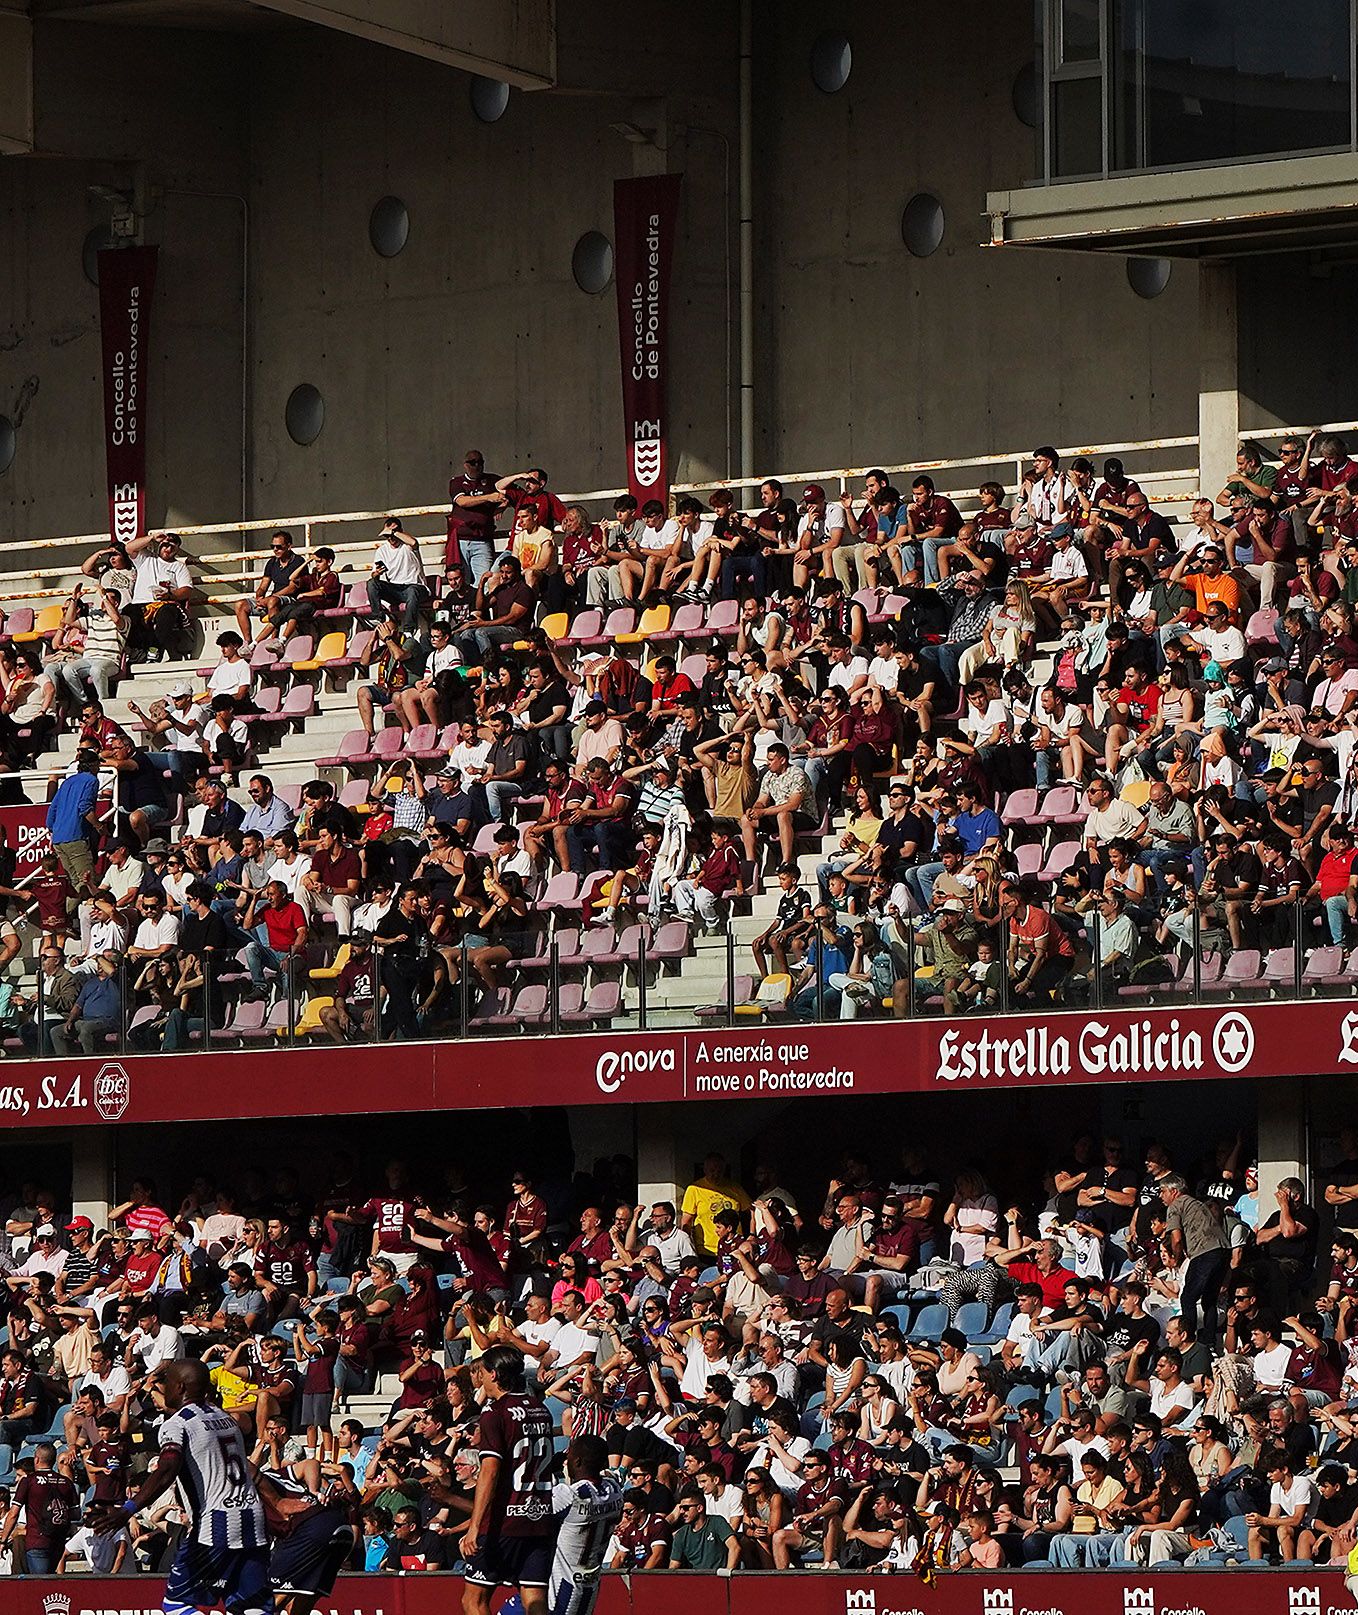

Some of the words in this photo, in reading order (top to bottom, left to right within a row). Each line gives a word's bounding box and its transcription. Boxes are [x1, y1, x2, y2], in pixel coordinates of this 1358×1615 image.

[646, 214, 659, 345] Pontevedra
[632, 282, 643, 381] Concello
[646, 351, 659, 379] de
[113, 351, 124, 446] Concello
[696, 1042, 709, 1063] A
[714, 1039, 773, 1063] enerxía
[777, 1043, 809, 1065] que
[935, 1026, 1072, 1081] Estrella
[1078, 1018, 1205, 1075] Galicia
[37, 1074, 88, 1110] S.A.
[696, 1074, 740, 1092] move
[744, 1074, 755, 1091] o
[759, 1067, 854, 1091] Pontevedra
[513, 1437, 553, 1491] 22
